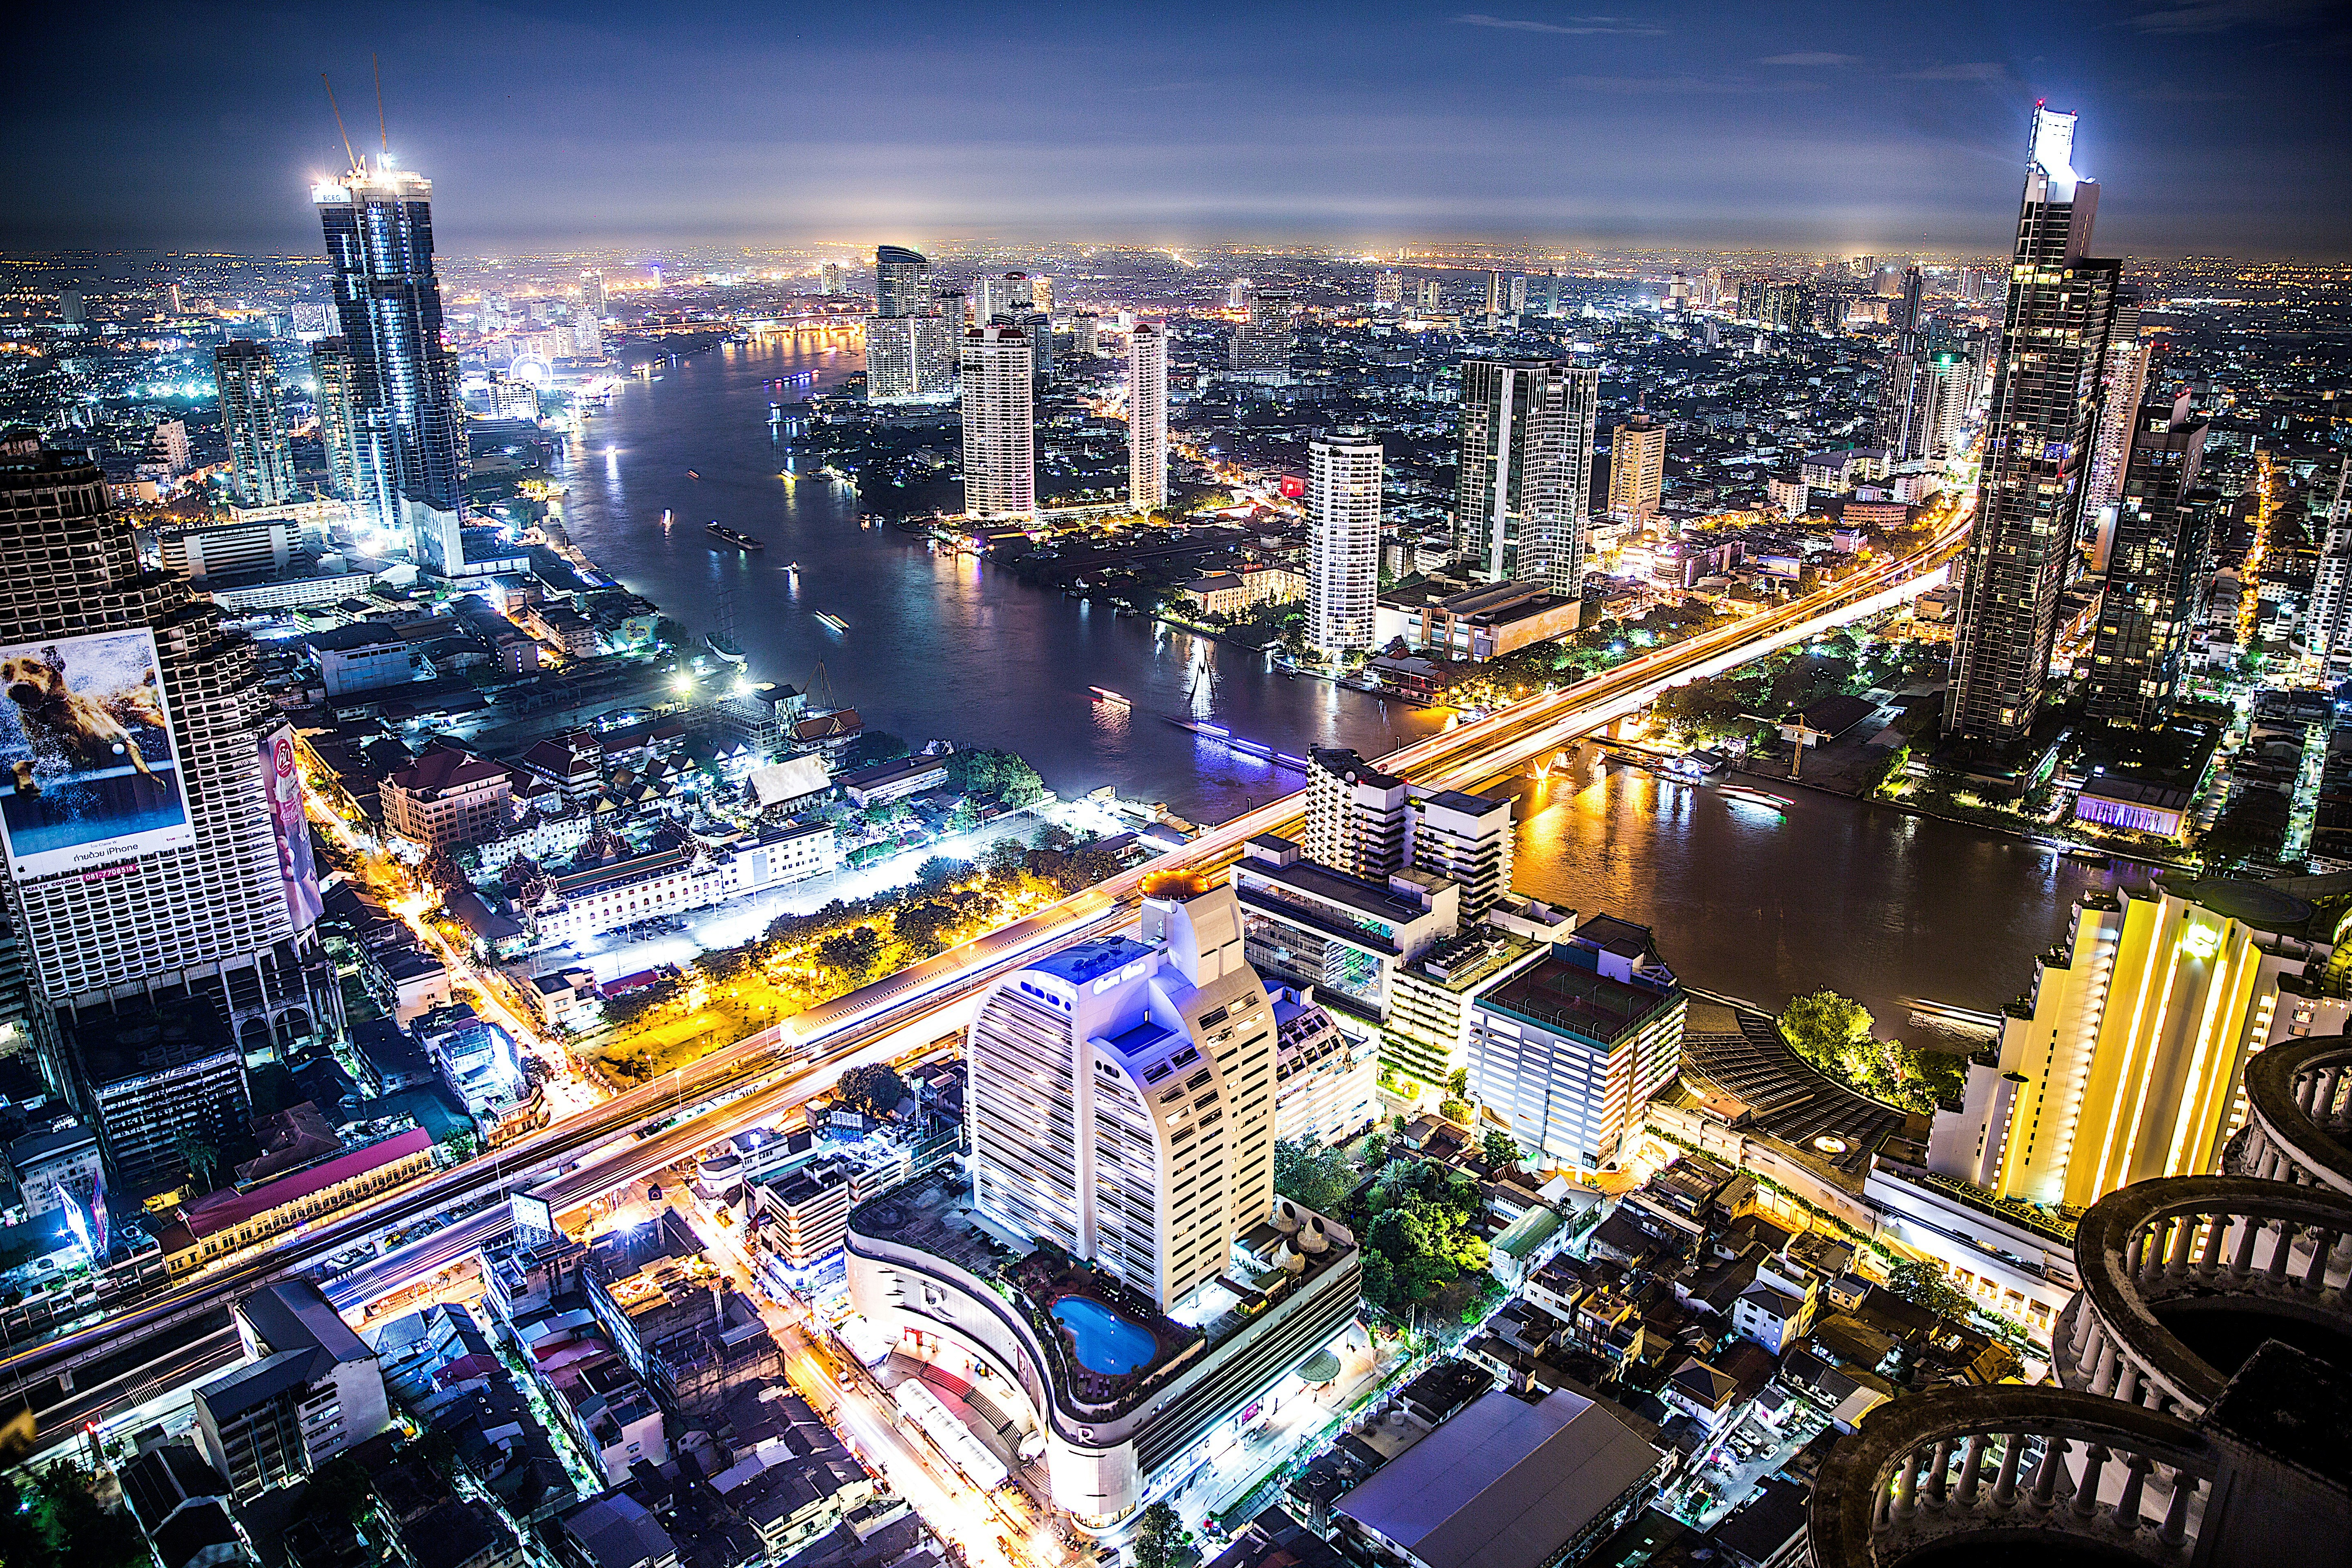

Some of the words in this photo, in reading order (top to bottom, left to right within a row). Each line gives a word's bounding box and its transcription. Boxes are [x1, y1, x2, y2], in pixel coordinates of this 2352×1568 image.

[2095, 802, 2119, 818] THE
[2123, 808, 2160, 828] RIVER
[74, 851, 105, 862] ถ่ายด้วย
[106, 844, 138, 856] iPhone
[26, 883, 49, 892] CMYK
[51, 877, 81, 887] COLOUR
[85, 864, 135, 880] 081-7708518
